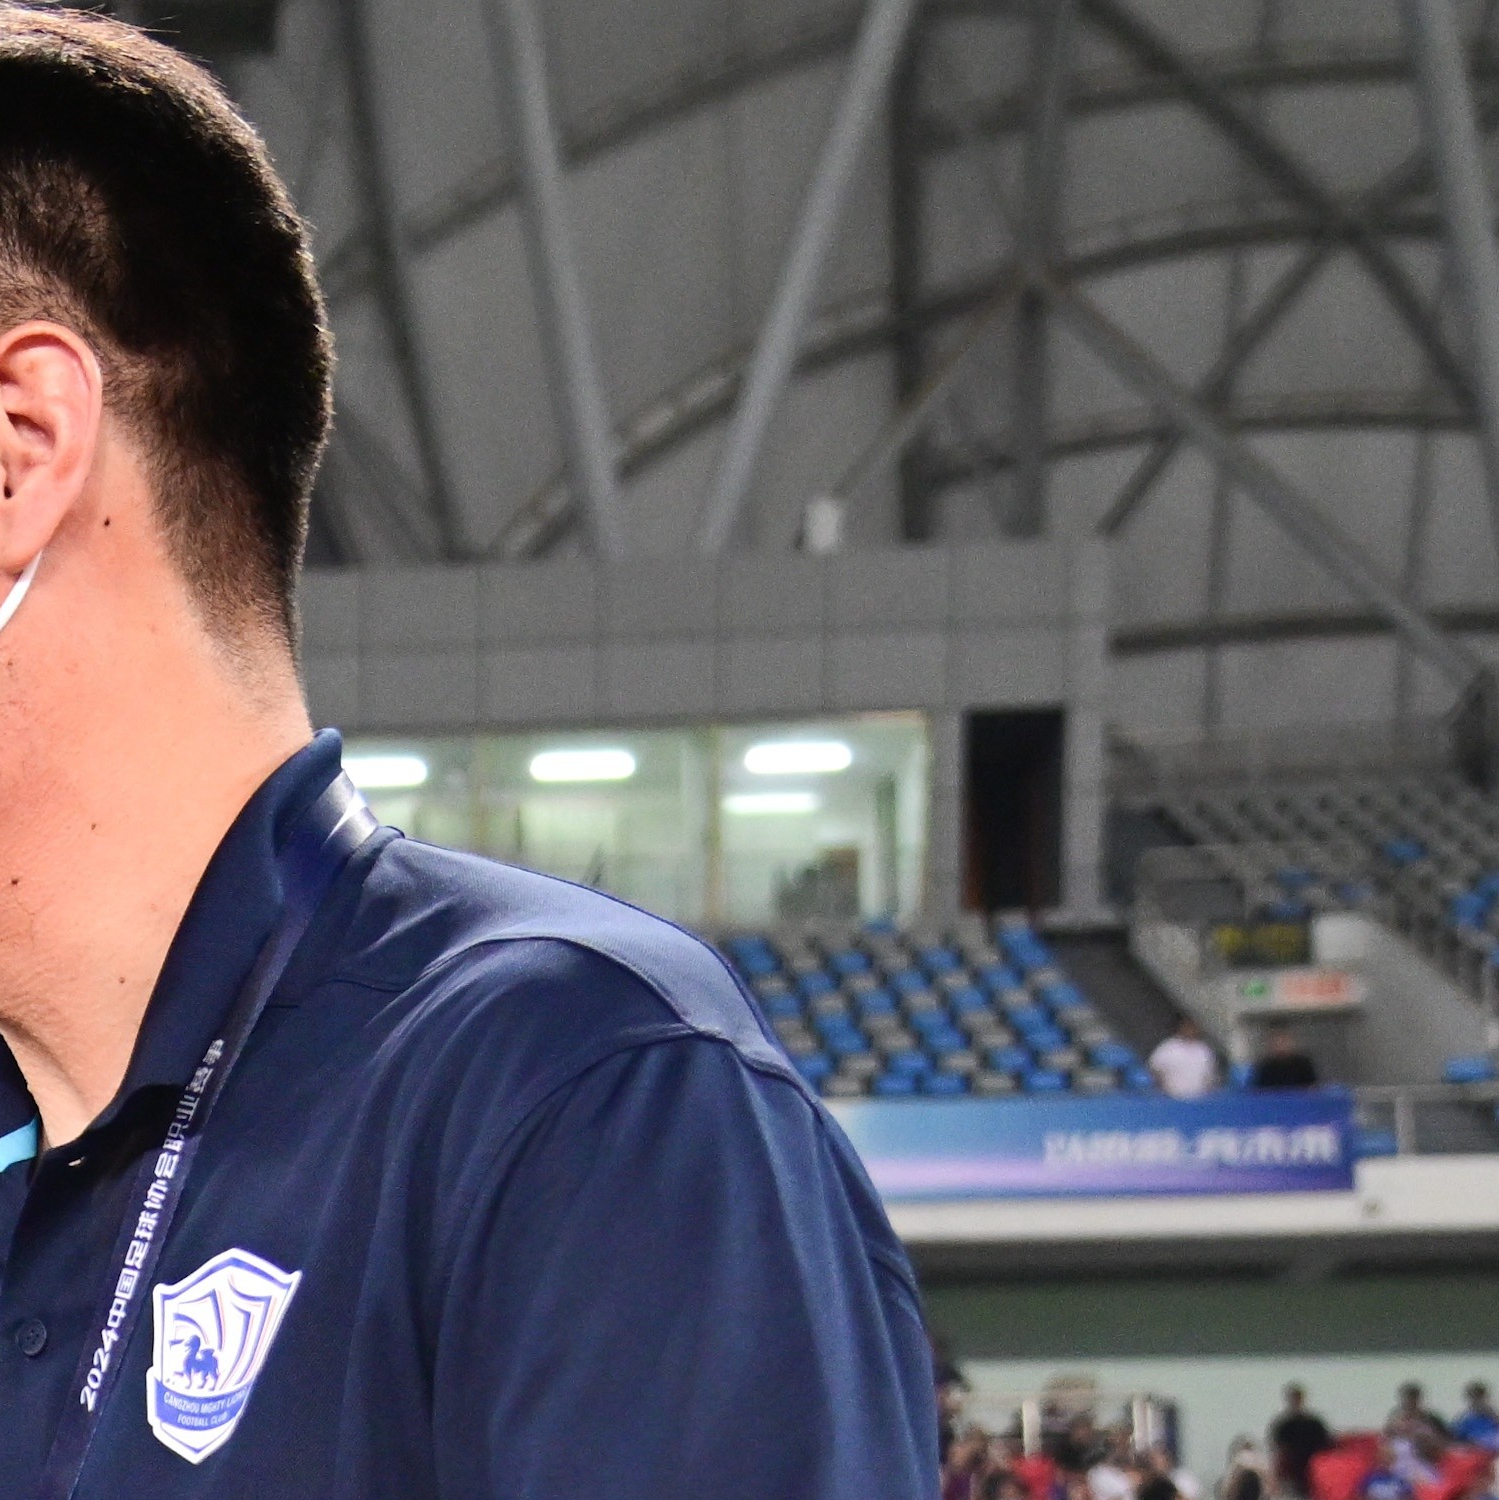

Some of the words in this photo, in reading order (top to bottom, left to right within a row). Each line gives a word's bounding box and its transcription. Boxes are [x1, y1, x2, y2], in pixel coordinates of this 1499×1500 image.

[80, 1039, 225, 1414] 2024中国足球协会职业赛事
[164, 1391, 200, 1413] CANGZHOU
[201, 1398, 226, 1413] MIGHTY
[177, 1413, 209, 1426] FOOTBALL
[211, 1412, 229, 1425] CLUB
